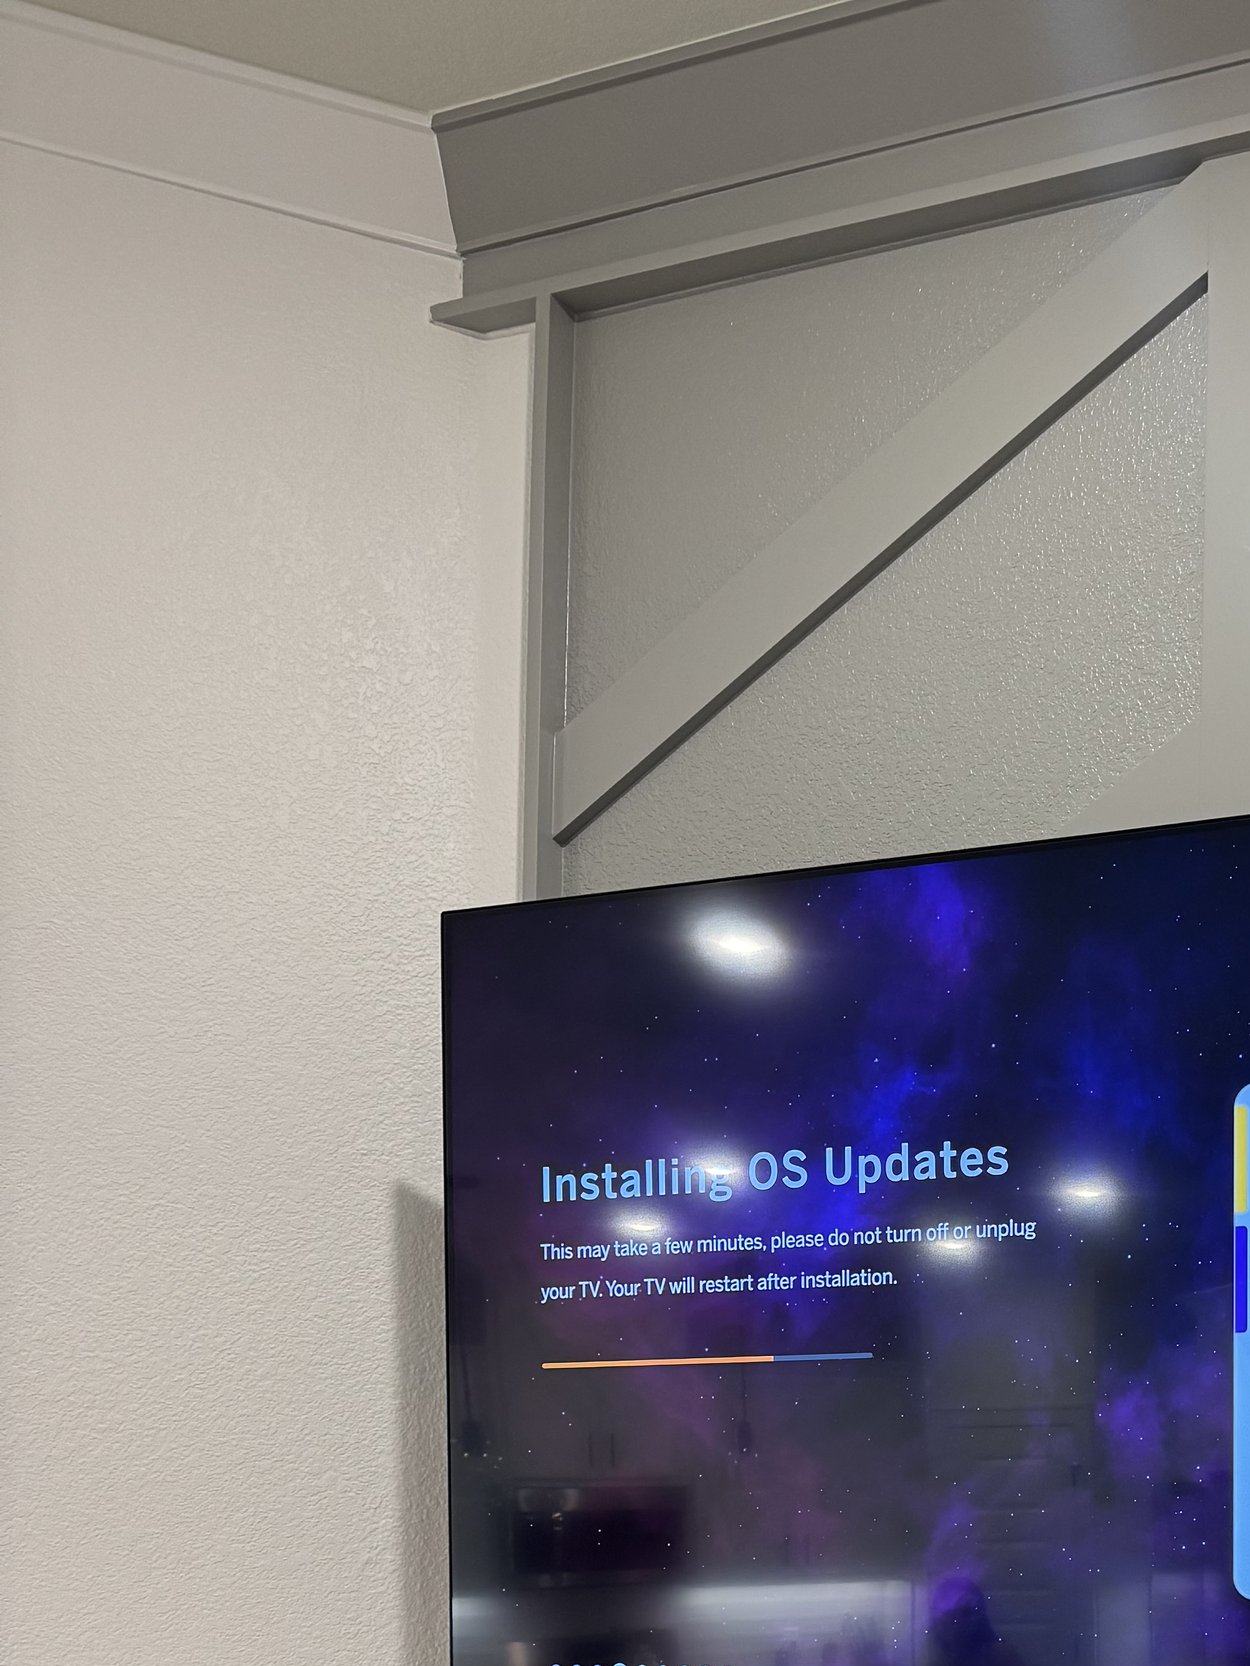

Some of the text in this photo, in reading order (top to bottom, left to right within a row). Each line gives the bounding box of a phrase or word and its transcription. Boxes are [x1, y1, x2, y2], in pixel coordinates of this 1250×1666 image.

[542, 1141, 1009, 1202] Installing OS Updates
[540, 1218, 1036, 1261] This may take a few minutes, please do not turn off or unplug
[540, 1268, 897, 1303] your TV. Your TV will restart after installation.
